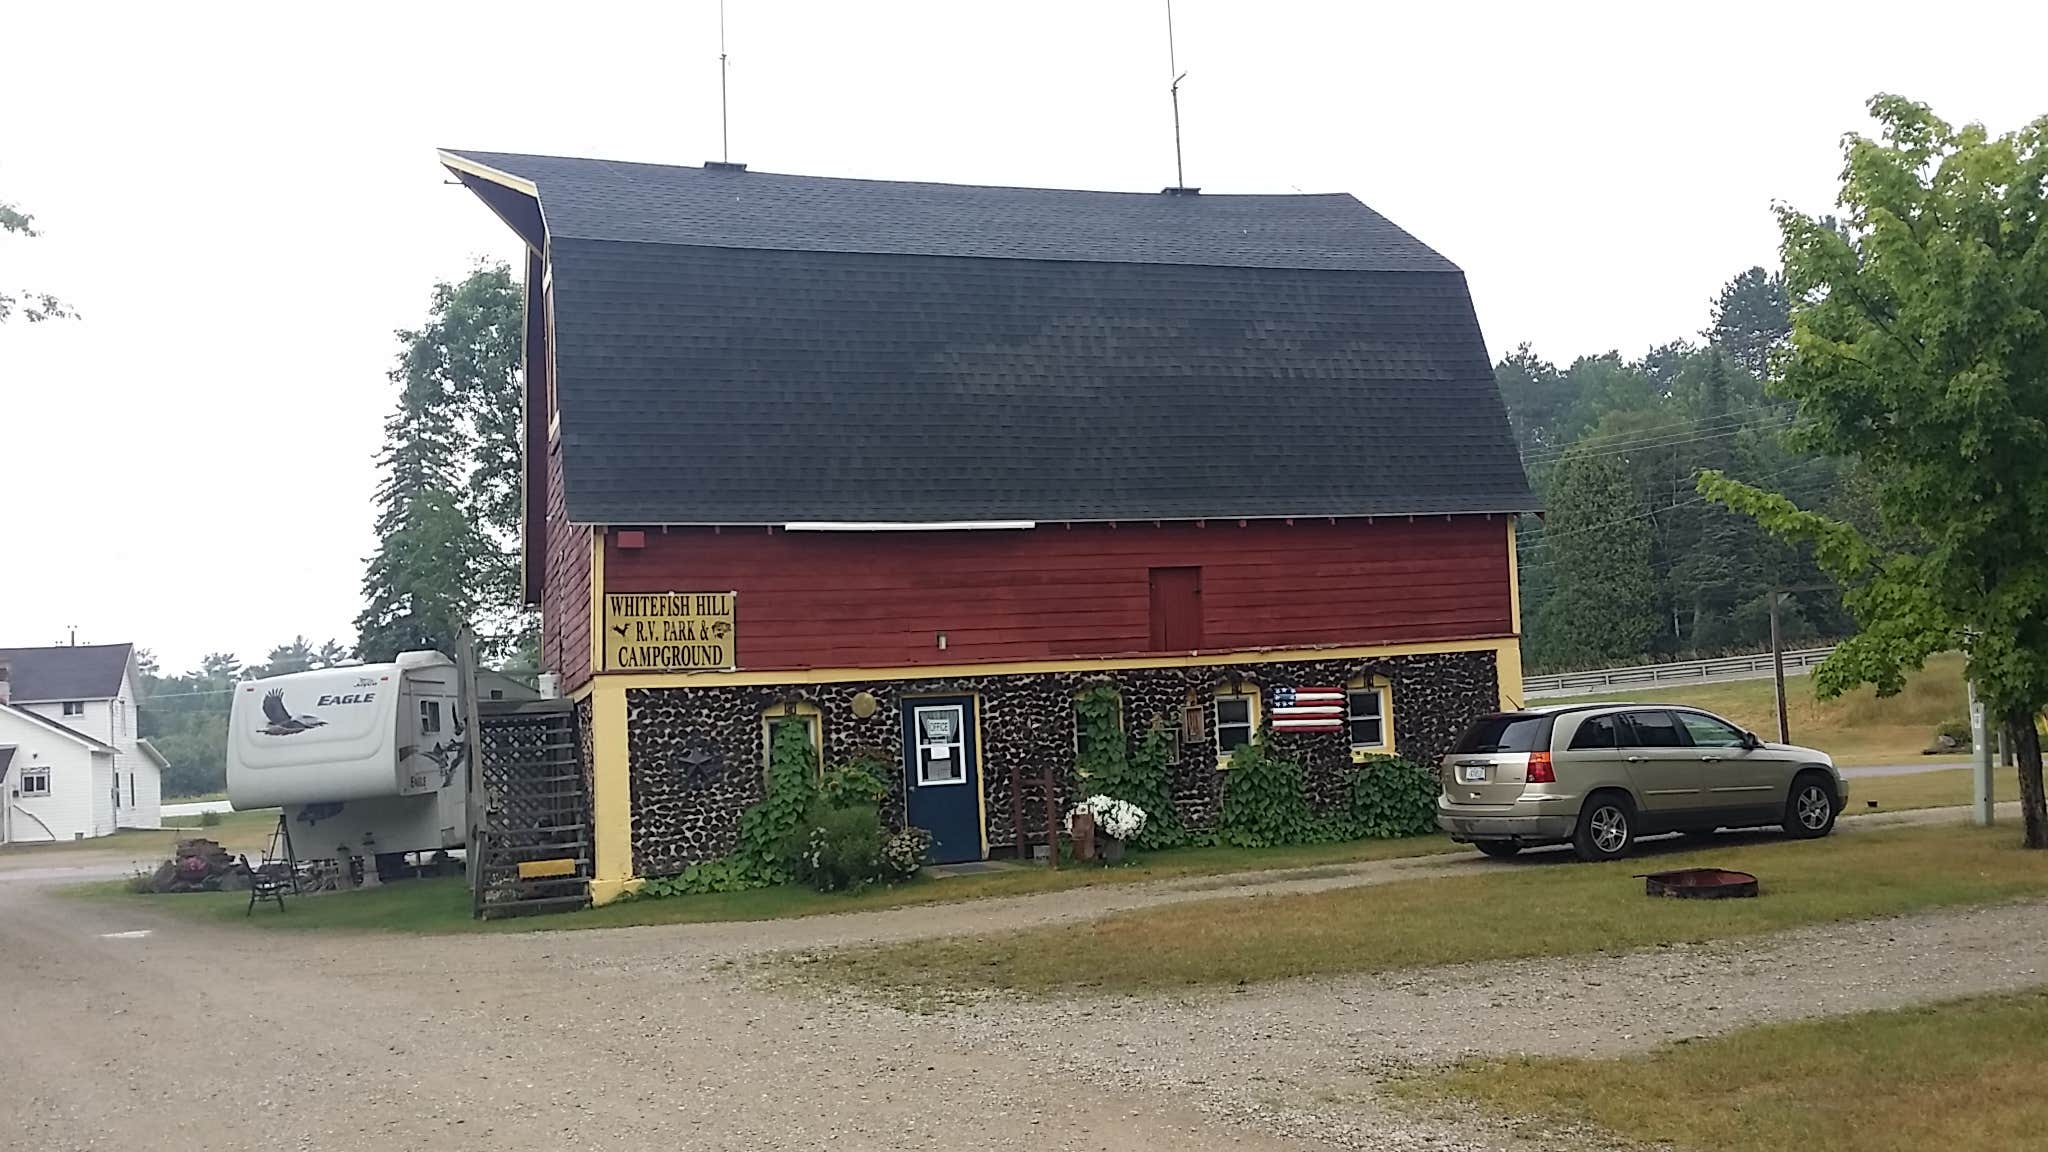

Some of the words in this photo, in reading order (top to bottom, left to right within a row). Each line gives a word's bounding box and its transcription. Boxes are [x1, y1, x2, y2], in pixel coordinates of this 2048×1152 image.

[610, 595, 690, 617] WHITEFISH
[696, 595, 730, 616] HILL
[636, 620, 659, 641] R.V.
[663, 620, 696, 641] PARK
[700, 620, 709, 641] &
[618, 645, 723, 667] CAMPGROUND
[317, 692, 376, 707] EAGLE
